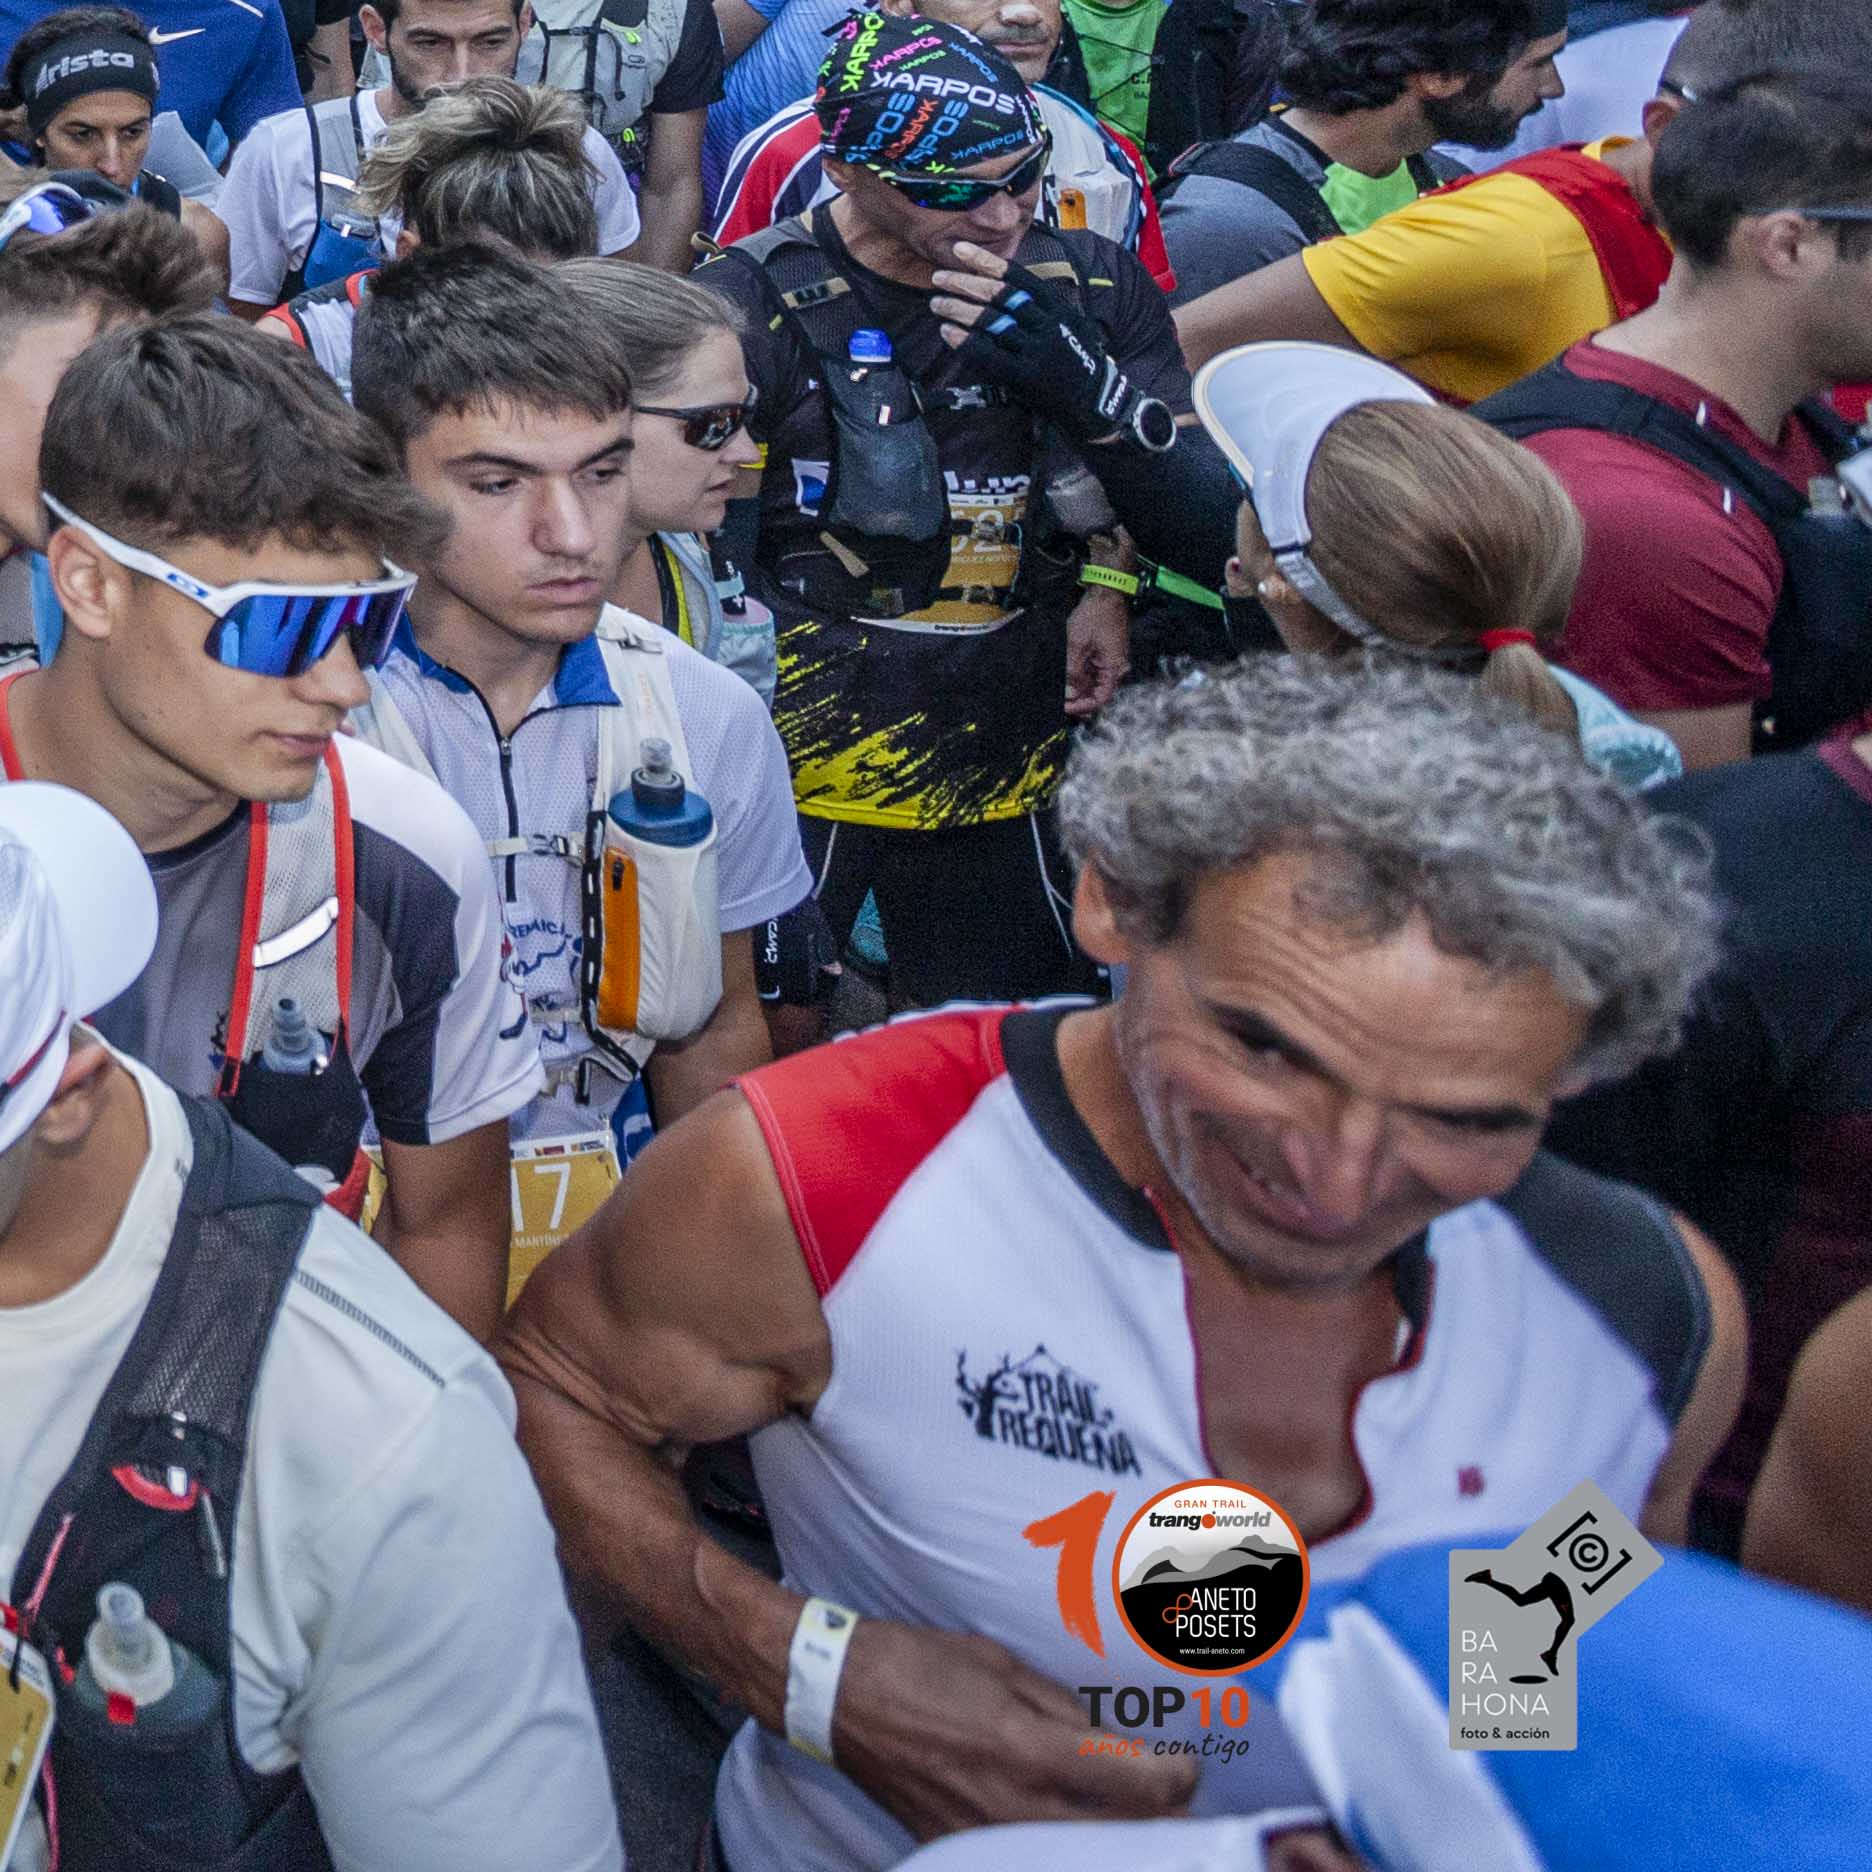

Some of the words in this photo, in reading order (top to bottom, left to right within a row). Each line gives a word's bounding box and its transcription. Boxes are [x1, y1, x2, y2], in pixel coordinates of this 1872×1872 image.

[34, 49, 136, 94] Arista
[868, 35, 944, 71] KARPOS
[947, 40, 1000, 84] KARPOS
[870, 70, 1017, 116] KARPOS
[949, 128, 1026, 161] KARPOS
[1016, 1366, 1102, 1425] TRAIL
[996, 1411, 1142, 1480] REQUENA
